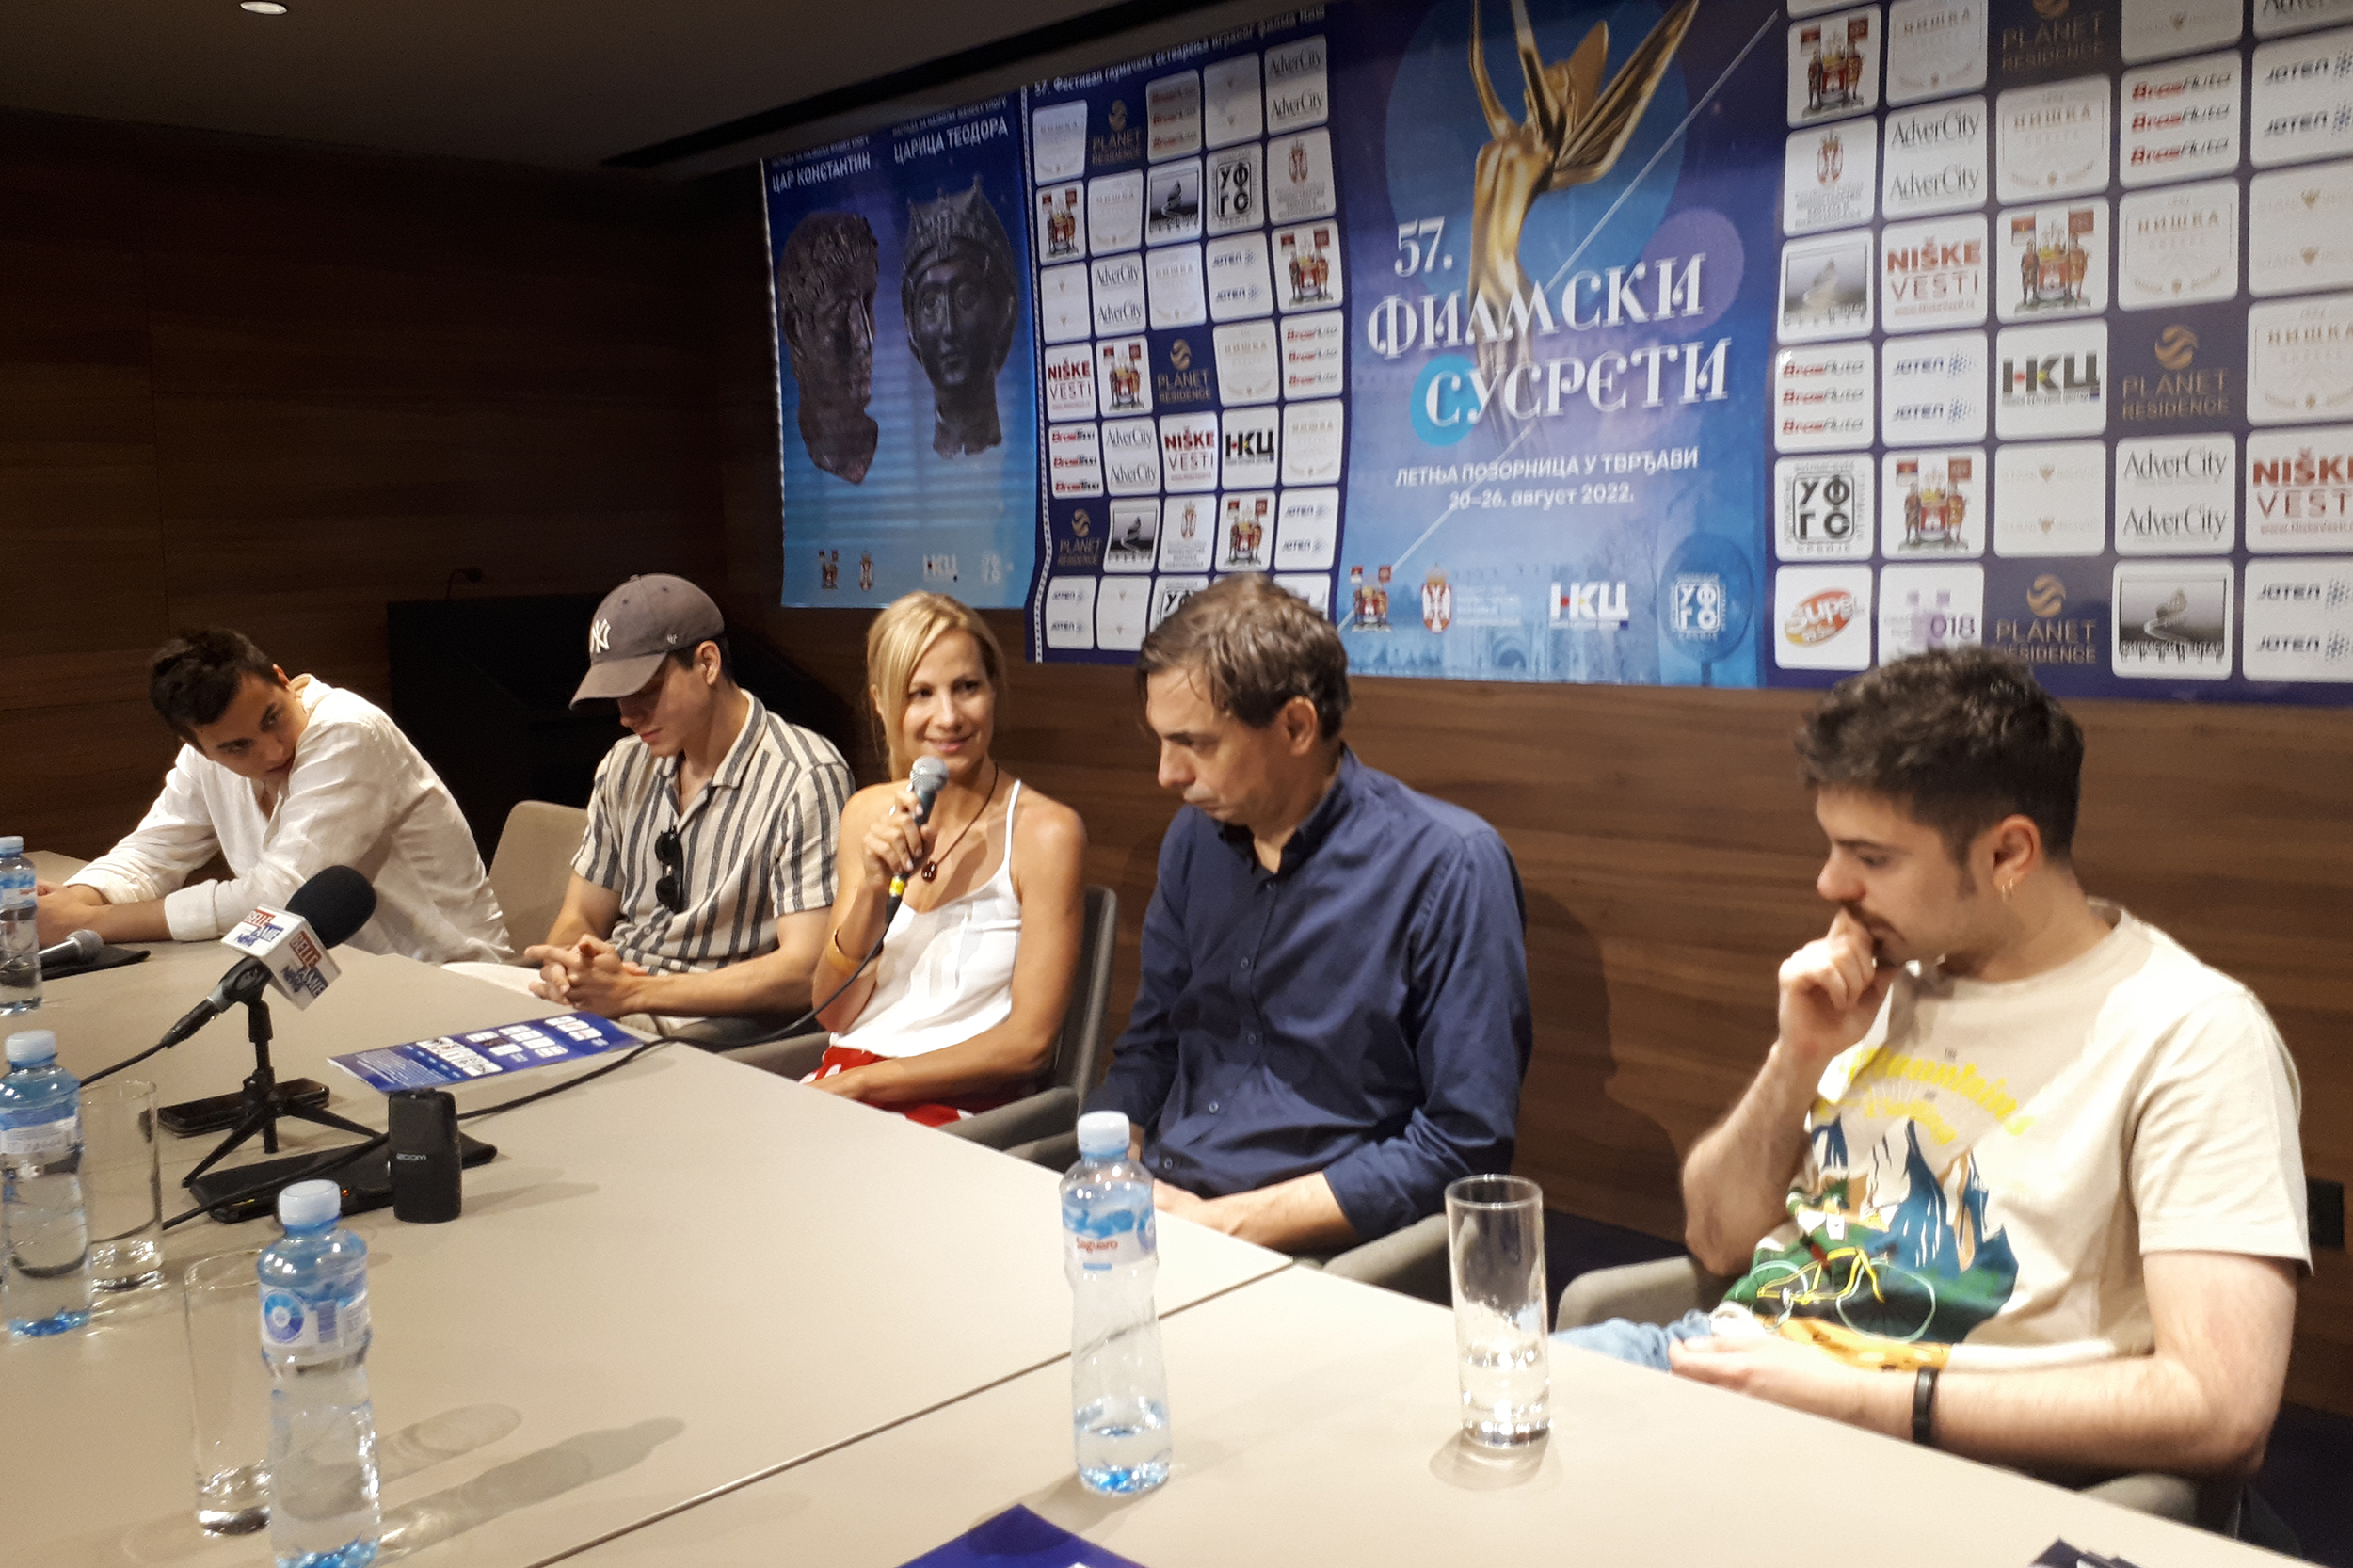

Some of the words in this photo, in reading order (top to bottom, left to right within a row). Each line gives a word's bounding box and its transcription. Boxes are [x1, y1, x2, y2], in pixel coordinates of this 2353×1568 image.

[2002, 10, 2104, 49] PLANET
[1272, 90, 1323, 118] AdverCity
[894, 131, 945, 165] ЦАРИЦА
[946, 116, 1008, 150] ТЕОДОРА
[1891, 110, 1980, 148] AdverCity
[772, 168, 794, 194] ЦАР
[797, 152, 872, 188] КОНСТАНТИН
[1889, 163, 1979, 200] AdverCity
[1394, 216, 1453, 277] 57.
[1887, 236, 1981, 273] NIŠKE
[1096, 262, 1139, 287] AdverCity
[1891, 267, 1978, 301] VESTI
[1097, 300, 1143, 325] AdverCity
[1368, 252, 1706, 360] ФИЛМСКИ
[1048, 357, 1091, 382] NIŠKE
[1158, 368, 1209, 390] PLANET
[1425, 337, 1732, 428] СУСРЕТИ
[2003, 351, 2100, 397] НКЦ
[2122, 367, 2228, 399] PLANET
[1048, 380, 1092, 401] VESTI
[2122, 395, 2230, 421] RESIDENCE
[1106, 424, 1153, 449] AdverCity
[1164, 425, 1215, 452] NIŠKE
[1110, 462, 1157, 486] AdverCity
[1168, 451, 1214, 472] VESTI
[1395, 463, 1458, 488] ЛЕТЊА
[1461, 456, 1579, 484] ПОЗОРНИЦА
[1584, 454, 1598, 475] У
[1602, 445, 1701, 476] ТВРЂАВИ
[2124, 446, 2227, 484] AdverCity
[2253, 446, 2353, 487] NIŠK
[1511, 488, 1577, 511] август
[1581, 481, 1635, 505] 2022.
[2123, 504, 2227, 541] AdverCity
[1060, 537, 1102, 554] PLANET
[1549, 580, 1630, 623] НКЦ
[589, 618, 611, 654] NY
[1997, 619, 2096, 644] PLANET
[289, 930, 323, 969] BELLE
[297, 965, 329, 999] AMIE
